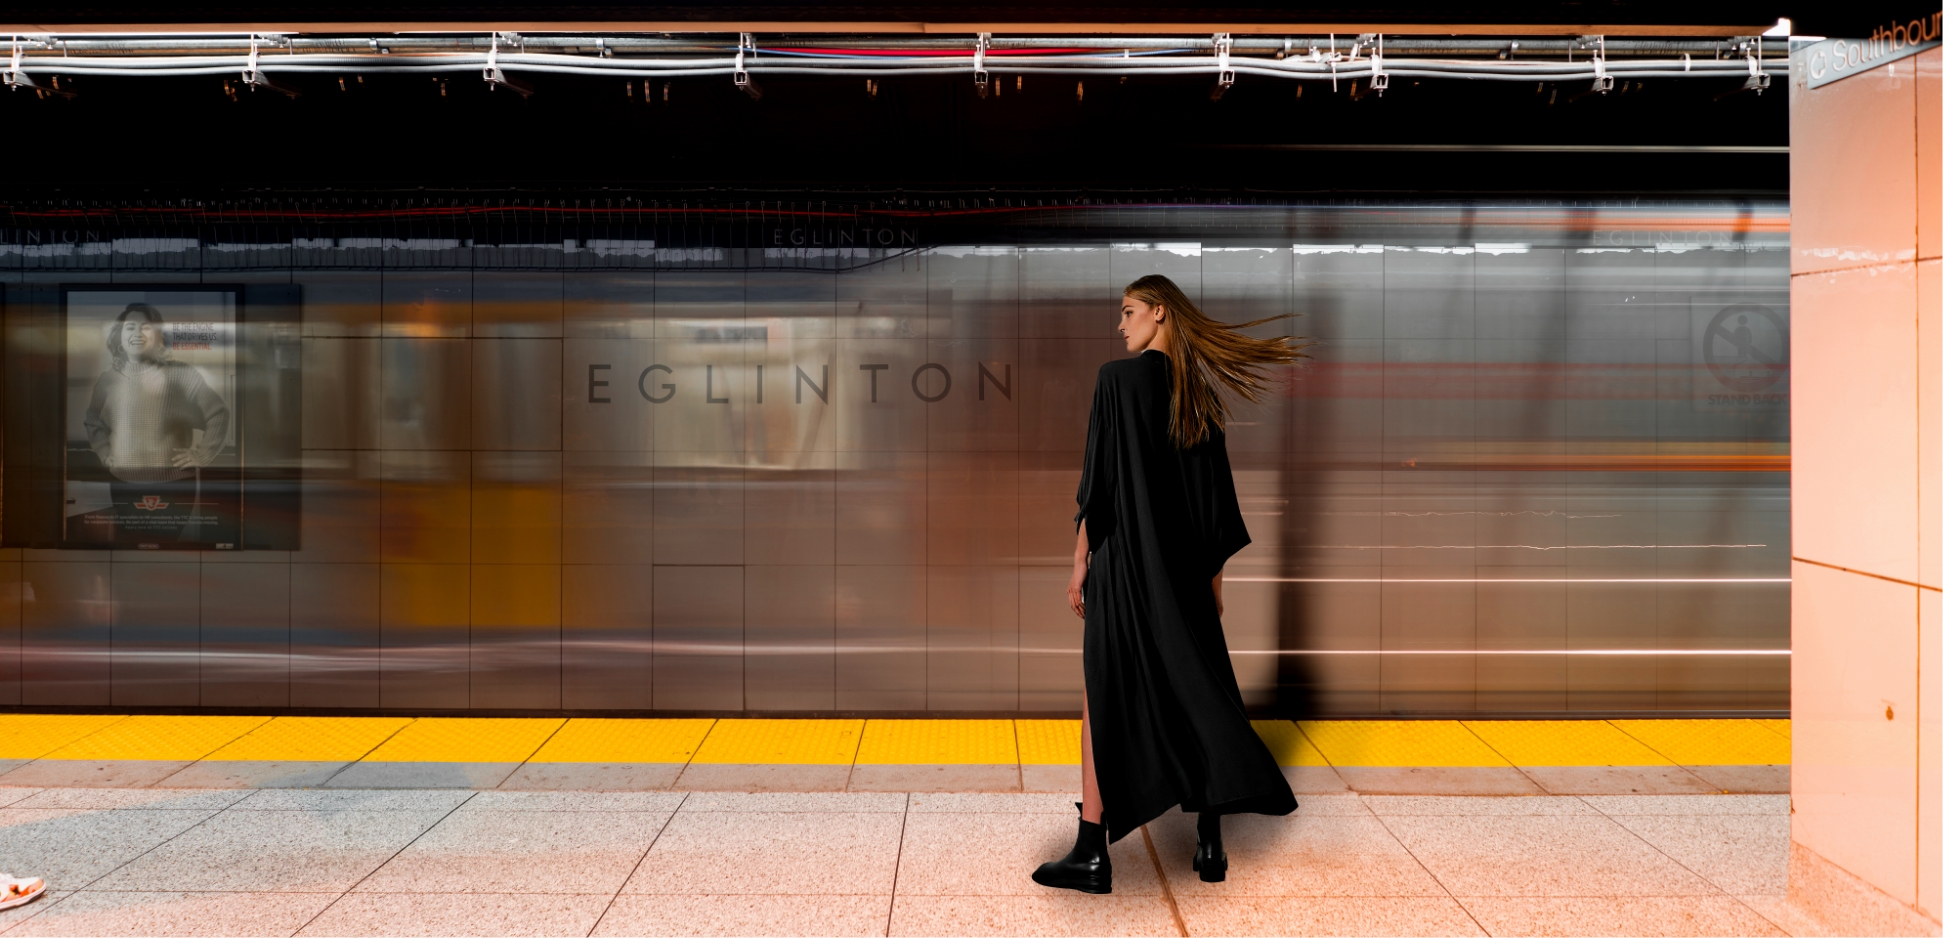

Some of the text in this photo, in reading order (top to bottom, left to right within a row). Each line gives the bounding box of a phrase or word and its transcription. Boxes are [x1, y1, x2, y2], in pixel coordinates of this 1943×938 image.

[774, 228, 916, 245] EGLINTON
[1593, 230, 1733, 246] EGLINTON
[173, 332, 218, 341] THAT DRIVES US.
[172, 342, 213, 351] BE ESSENTIAL.
[587, 361, 1012, 405] EGLINTON
[1708, 394, 1788, 405] STAND BACK
